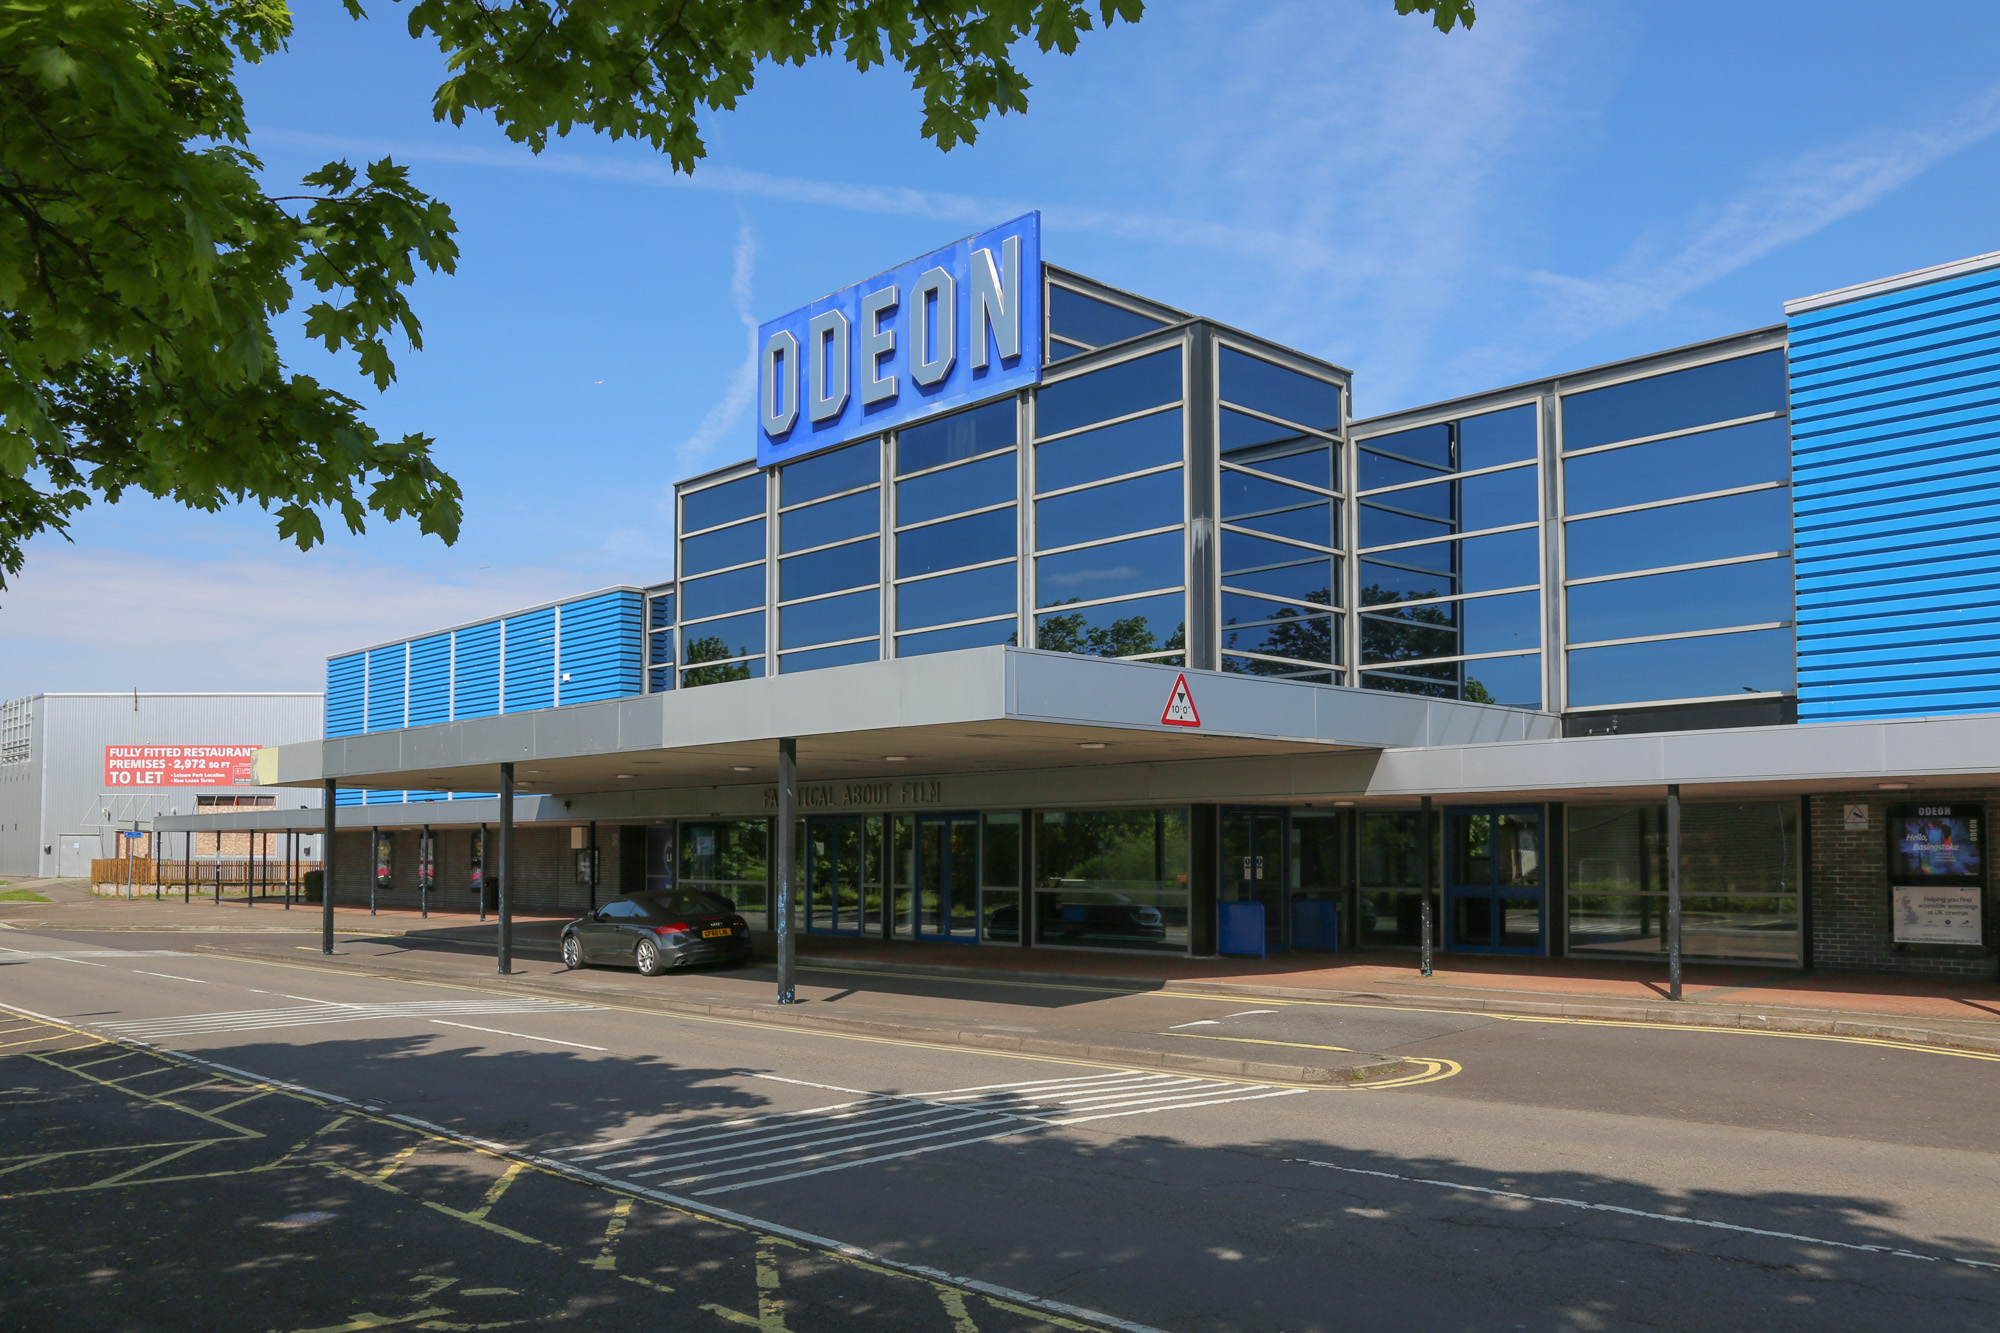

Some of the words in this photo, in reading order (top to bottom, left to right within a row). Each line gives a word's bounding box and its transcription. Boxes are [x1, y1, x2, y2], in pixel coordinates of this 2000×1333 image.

[761, 235, 1022, 436] ODEON
[109, 748, 142, 757] FULLY
[144, 748, 181, 757] FITTED
[109, 759, 166, 768] PREMISES
[174, 758, 206, 770] 2,972
[110, 771, 131, 784] TO
[136, 772, 164, 784] LET
[762, 785, 836, 808] FATICAL
[842, 782, 892, 806] ABOUT
[900, 781, 941, 804] FILM
[1918, 807, 1951, 816] ODEON
[1970, 819, 1978, 842] ODEON
[1906, 834, 1928, 842] Hello,
[1912, 843, 1960, 851] Basingstoke
